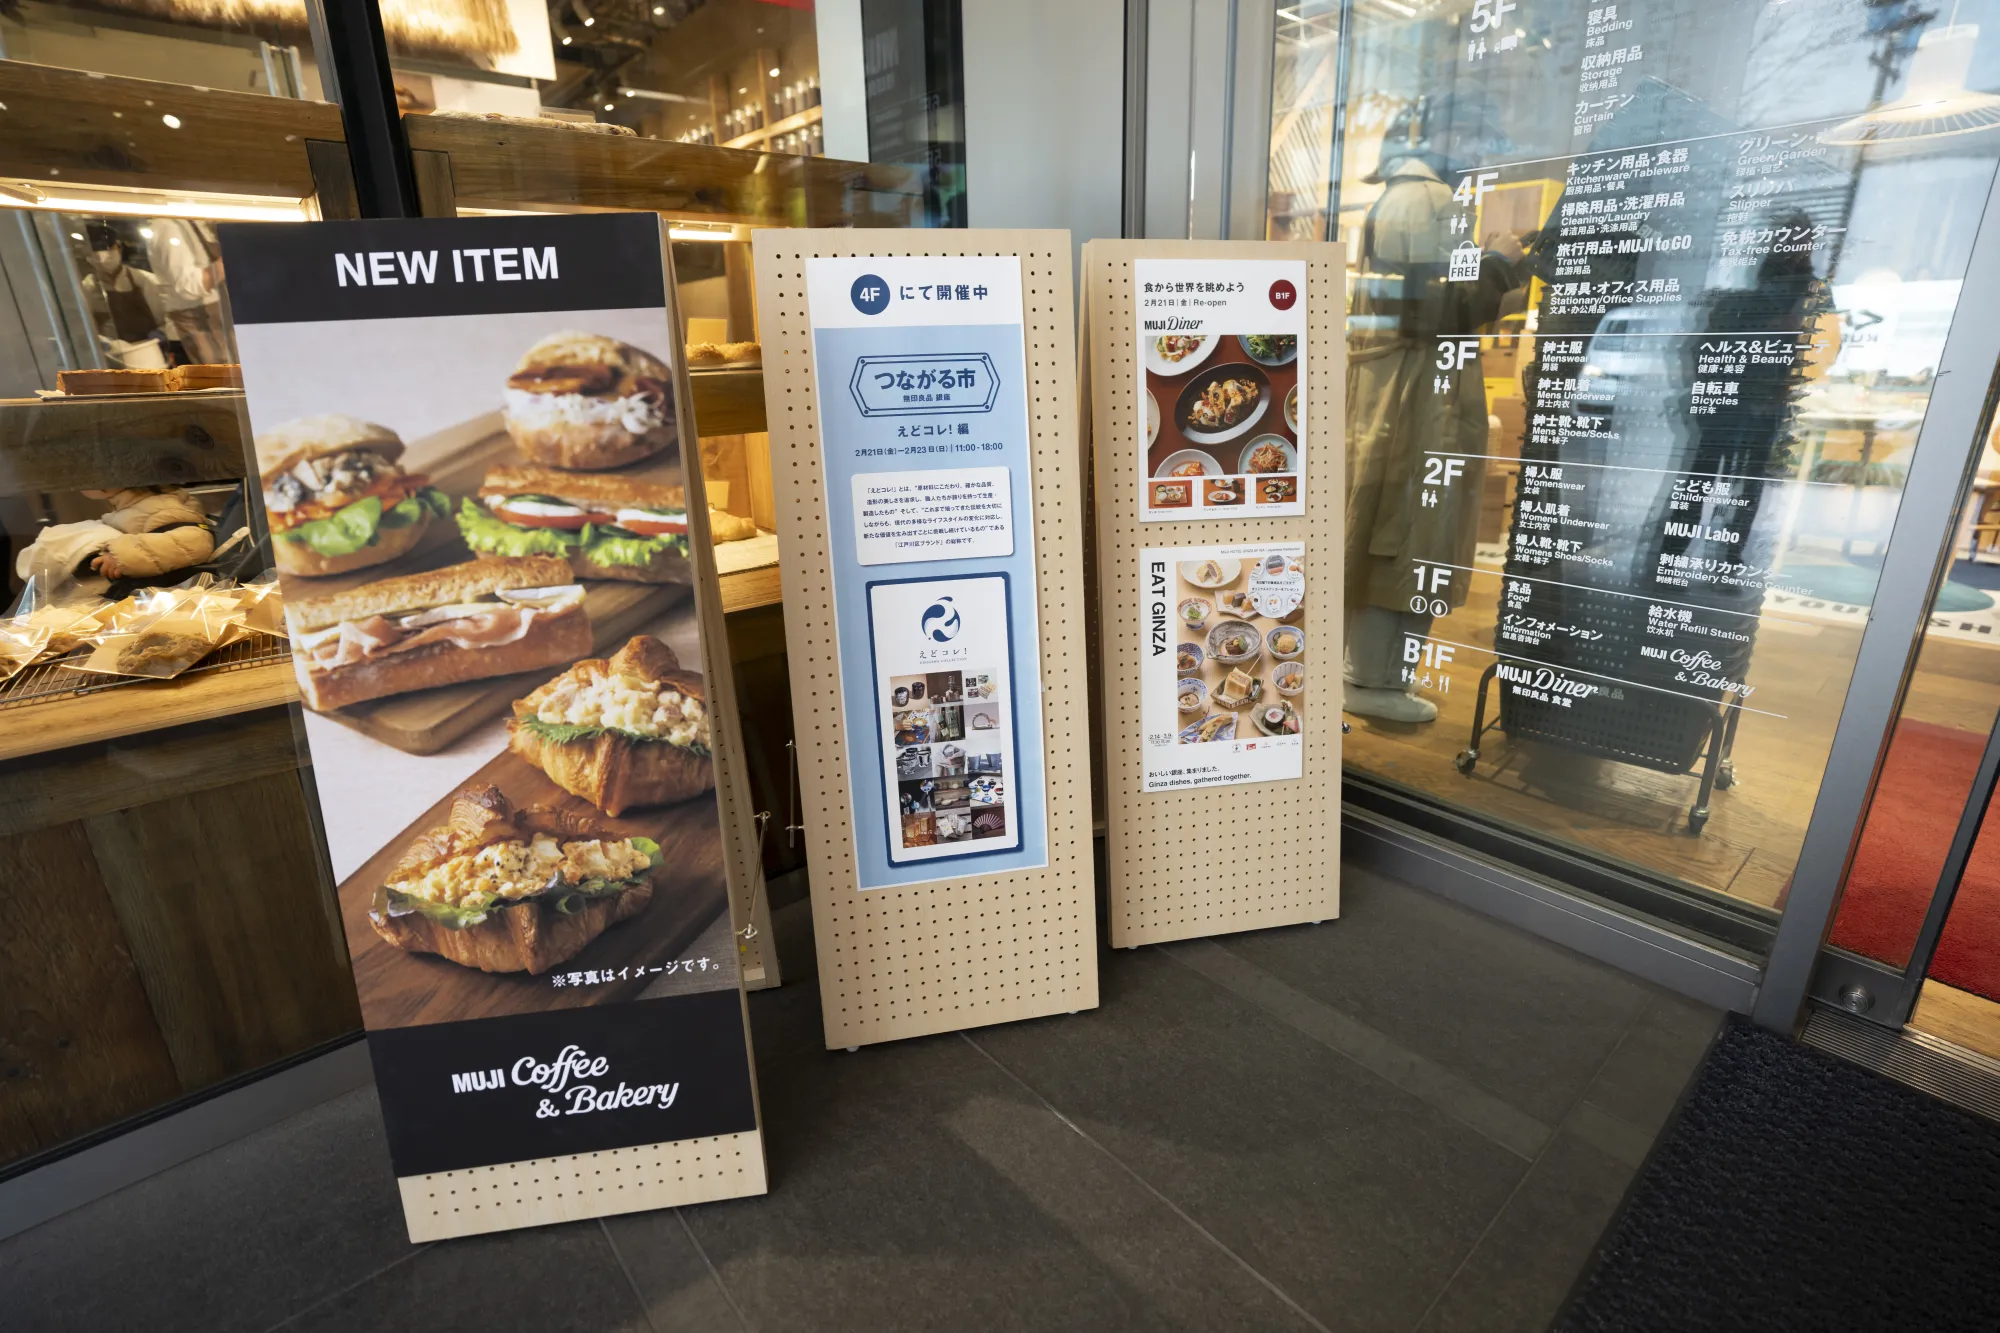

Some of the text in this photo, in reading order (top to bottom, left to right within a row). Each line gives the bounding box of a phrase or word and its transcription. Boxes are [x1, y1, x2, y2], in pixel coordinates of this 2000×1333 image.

[1470, 0, 1516, 33] 5F
[1587, 5, 1617, 26] 寝具
[1587, 19, 1632, 36] Bedding
[1585, 36, 1605, 48] 床品
[1581, 45, 1642, 71] 収納用品
[1580, 67, 1622, 81] Storage
[1575, 93, 1635, 115] カーテン
[1574, 111, 1614, 125] Curtain
[1737, 147, 1827, 166] Green/Garden
[1566, 163, 1690, 186] Kitchenware/Tableware
[1453, 172, 1498, 207] 4F
[1729, 198, 1773, 213] Slipper
[1561, 211, 1650, 226] Cleaning/Laundry
[1655, 240, 1672, 250] to
[1671, 234, 1692, 250] GO
[1720, 226, 1847, 247] 免税カウンター
[1721, 241, 1826, 257] Tax-free Counter
[334, 246, 559, 287] NEW ITEM
[1453, 253, 1478, 264] TAX
[1557, 256, 1587, 266] Travel
[1451, 266, 1477, 278] FREE
[860, 287, 881, 302] 4F
[900, 285, 988, 300] にて開催中
[1144, 282, 1245, 293] 食から世界を眺めよう
[1275, 292, 1290, 300] B1F
[1550, 293, 1682, 307] Stationary/Office Supplies
[1144, 316, 1203, 331] MUJI Diner
[1436, 340, 1480, 370] 3F
[1543, 341, 1583, 355] 紳士服
[1542, 363, 1558, 372] 男装
[1699, 355, 1795, 366] Health & Beauty
[874, 368, 976, 390] つながる市
[1538, 378, 1590, 392] 紳士肌着
[1537, 391, 1615, 401] Mens Underwear
[1691, 381, 1739, 395] 自転車
[903, 394, 933, 402] 無印良品
[1537, 399, 1570, 409] 男士内衣
[1691, 396, 1739, 406] Bicycles
[958, 423, 969, 435] 編
[1532, 427, 1619, 440] Mens Shoes/Socks
[1423, 457, 1465, 486] 2F
[1525, 466, 1562, 480] 婦人服
[1523, 486, 1540, 495] 女装
[1525, 478, 1586, 491] Womenswear
[1672, 479, 1731, 496] こども服
[1671, 491, 1750, 508] Childrenswear
[1520, 500, 1571, 517] 婦人肌着
[1519, 520, 1551, 531] 女士内衣
[1520, 512, 1610, 531] Womens Underwear
[1663, 522, 1740, 544] MUJI Labo
[1515, 546, 1553, 558] Womens
[1554, 551, 1614, 567] Shoes/Socks
[1413, 565, 1452, 594] 1F
[1657, 566, 1814, 596] Embroidery Service Counter
[1508, 581, 1532, 595] 食品
[1507, 600, 1522, 610] 食品
[1508, 593, 1530, 603] Food
[1151, 561, 1166, 657] EAT GINZA
[1648, 604, 1693, 623] 給水機
[1503, 612, 1603, 642] インフォメーション
[1503, 623, 1551, 640] Information
[1648, 618, 1750, 643] Water Refill Station
[1403, 637, 1456, 670] B1F
[1641, 646, 1722, 672] MUJI Coffee
[1496, 664, 1532, 686] MUJI
[1533, 668, 1598, 699] Diner
[1675, 671, 1756, 698] & Bakery
[1512, 685, 1572, 708] 無印良品 食堂
[1169, 778, 1192, 786] dishes,
[1194, 776, 1221, 784] gathered
[1223, 773, 1251, 781] together.
[552, 957, 720, 987] ※写真はイメージです。
[451, 1044, 609, 1093] MUJI Coffee
[535, 1081, 679, 1119] & Bakery
